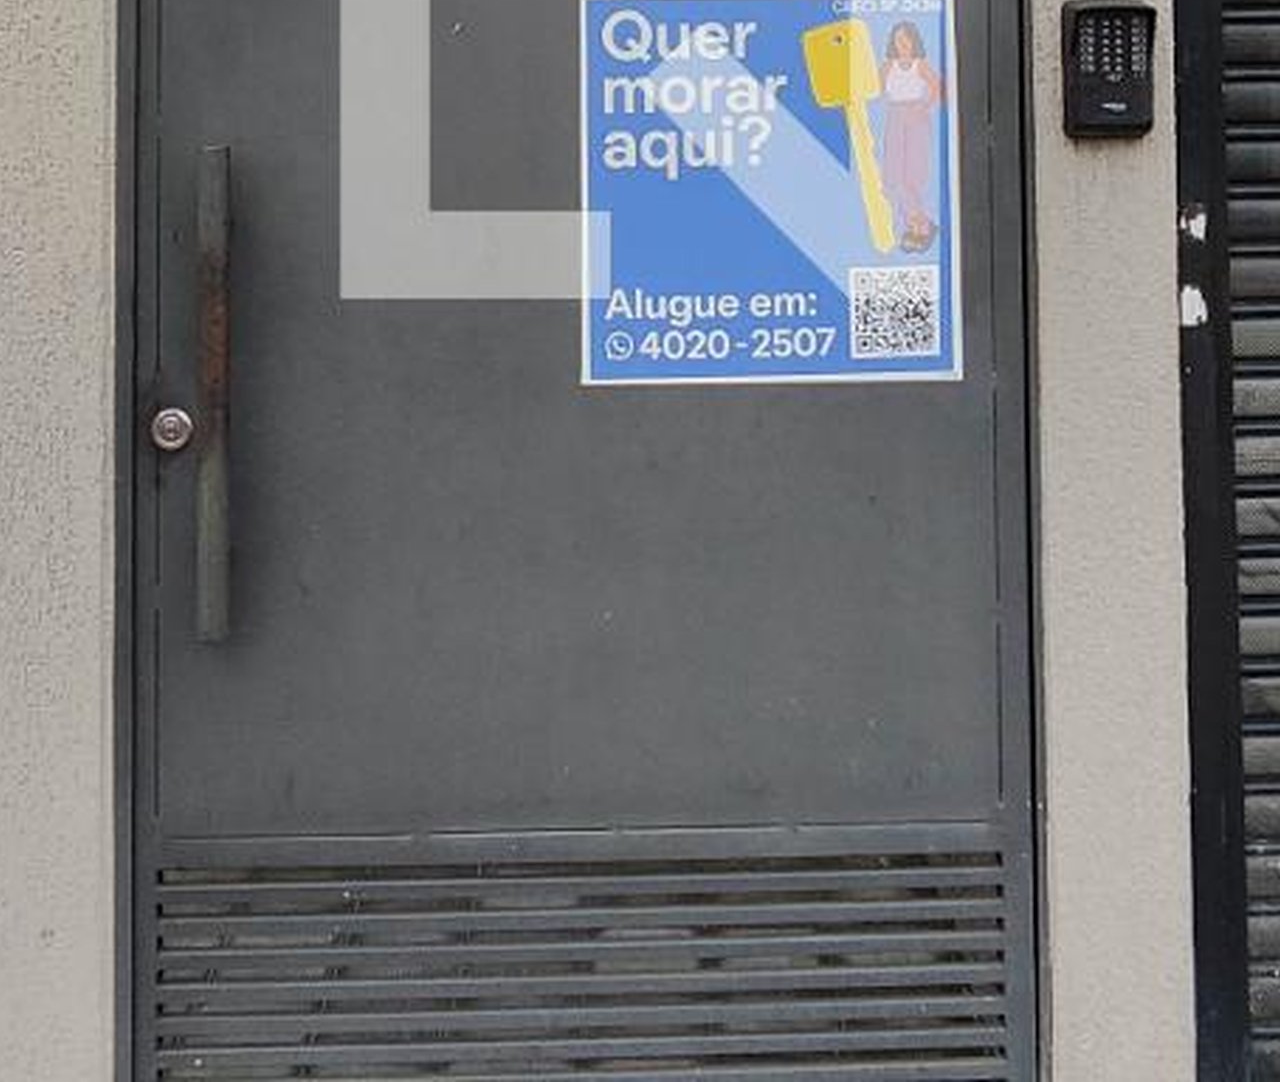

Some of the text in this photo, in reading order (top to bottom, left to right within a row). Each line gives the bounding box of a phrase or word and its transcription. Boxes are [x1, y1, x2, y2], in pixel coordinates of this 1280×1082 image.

[601, 8, 758, 64] Quer
[603, 74, 789, 114] morar
[602, 114, 773, 181] aqui?
[604, 288, 818, 328] Alugue em:
